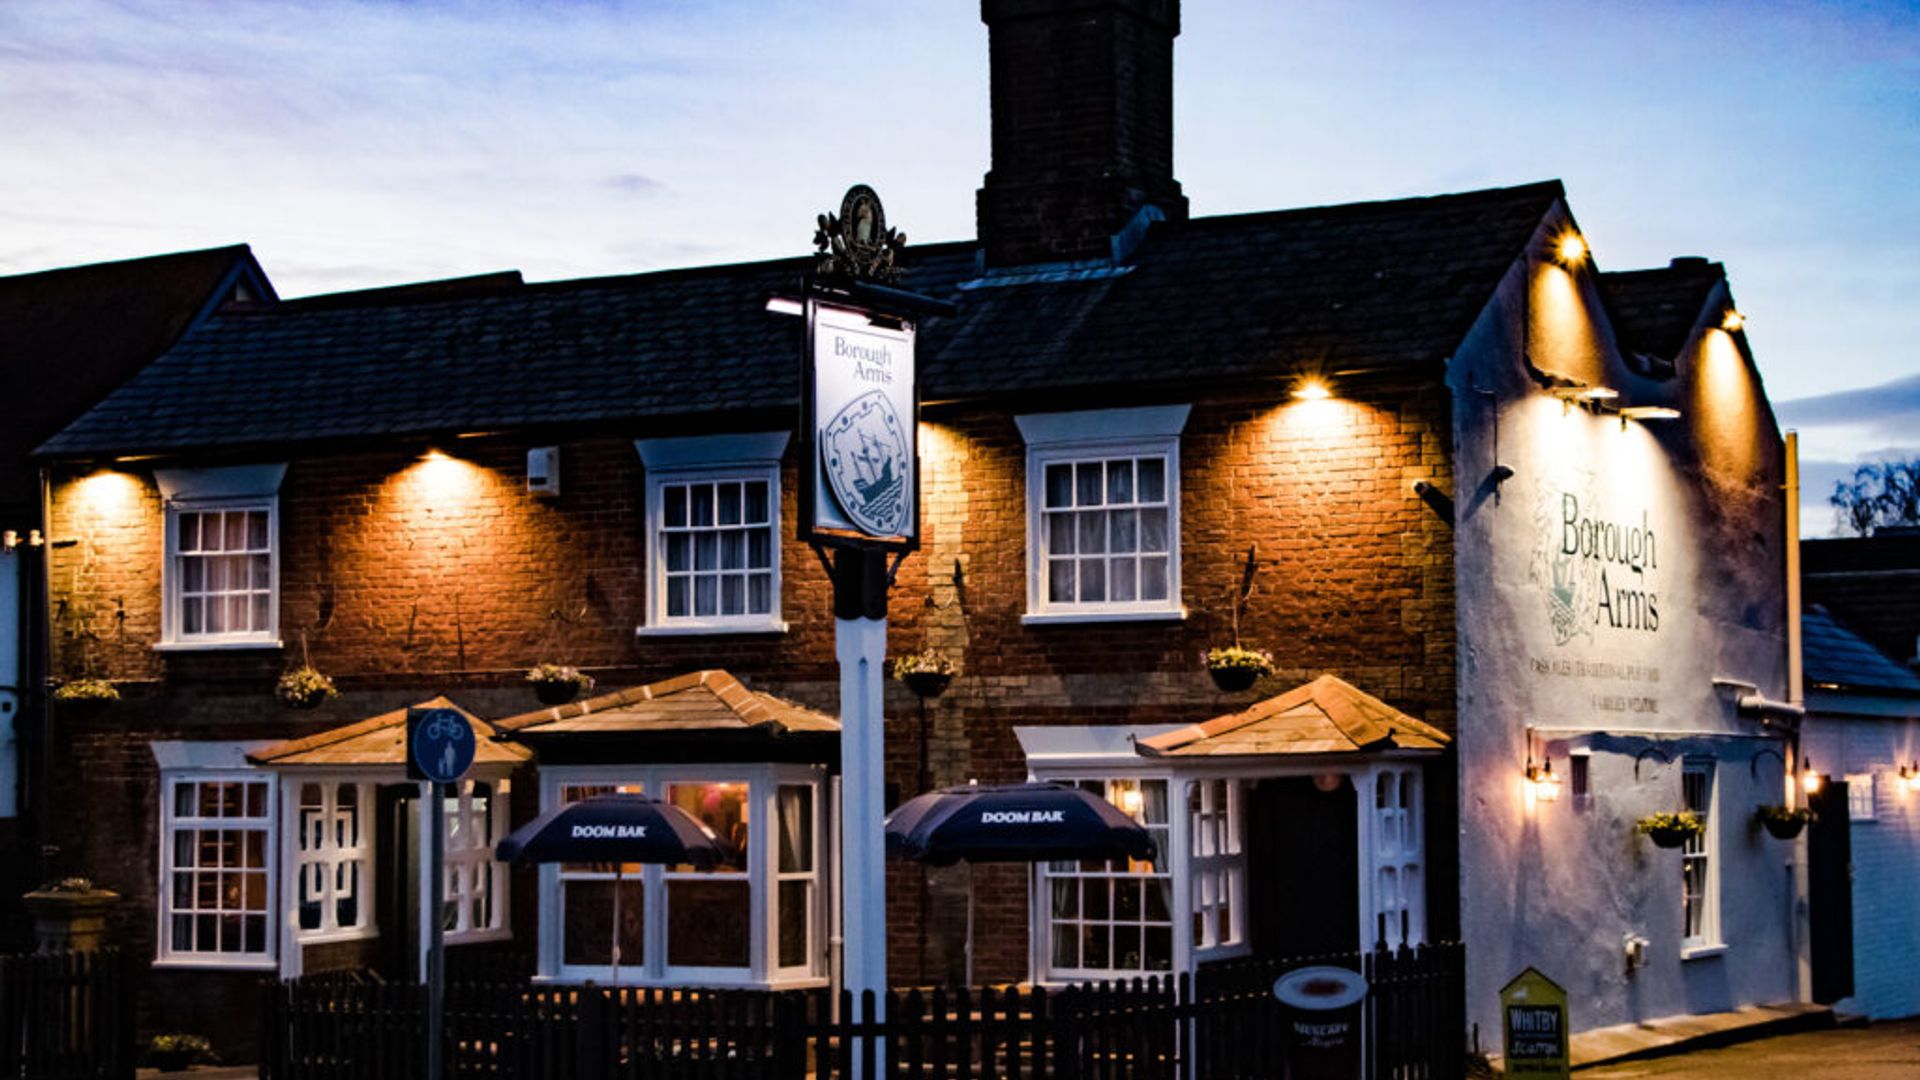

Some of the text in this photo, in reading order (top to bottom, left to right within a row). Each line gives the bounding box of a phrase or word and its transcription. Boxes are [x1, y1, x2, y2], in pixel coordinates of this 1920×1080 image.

[834, 335, 892, 367] Borough
[853, 361, 893, 384] Arms
[1561, 492, 1657, 584] Borough
[1594, 567, 1659, 632] Arms
[981, 810, 1064, 824] DOOM BAR
[572, 825, 647, 838] DOOM BAR
[1510, 1008, 1558, 1031] WHITBY
